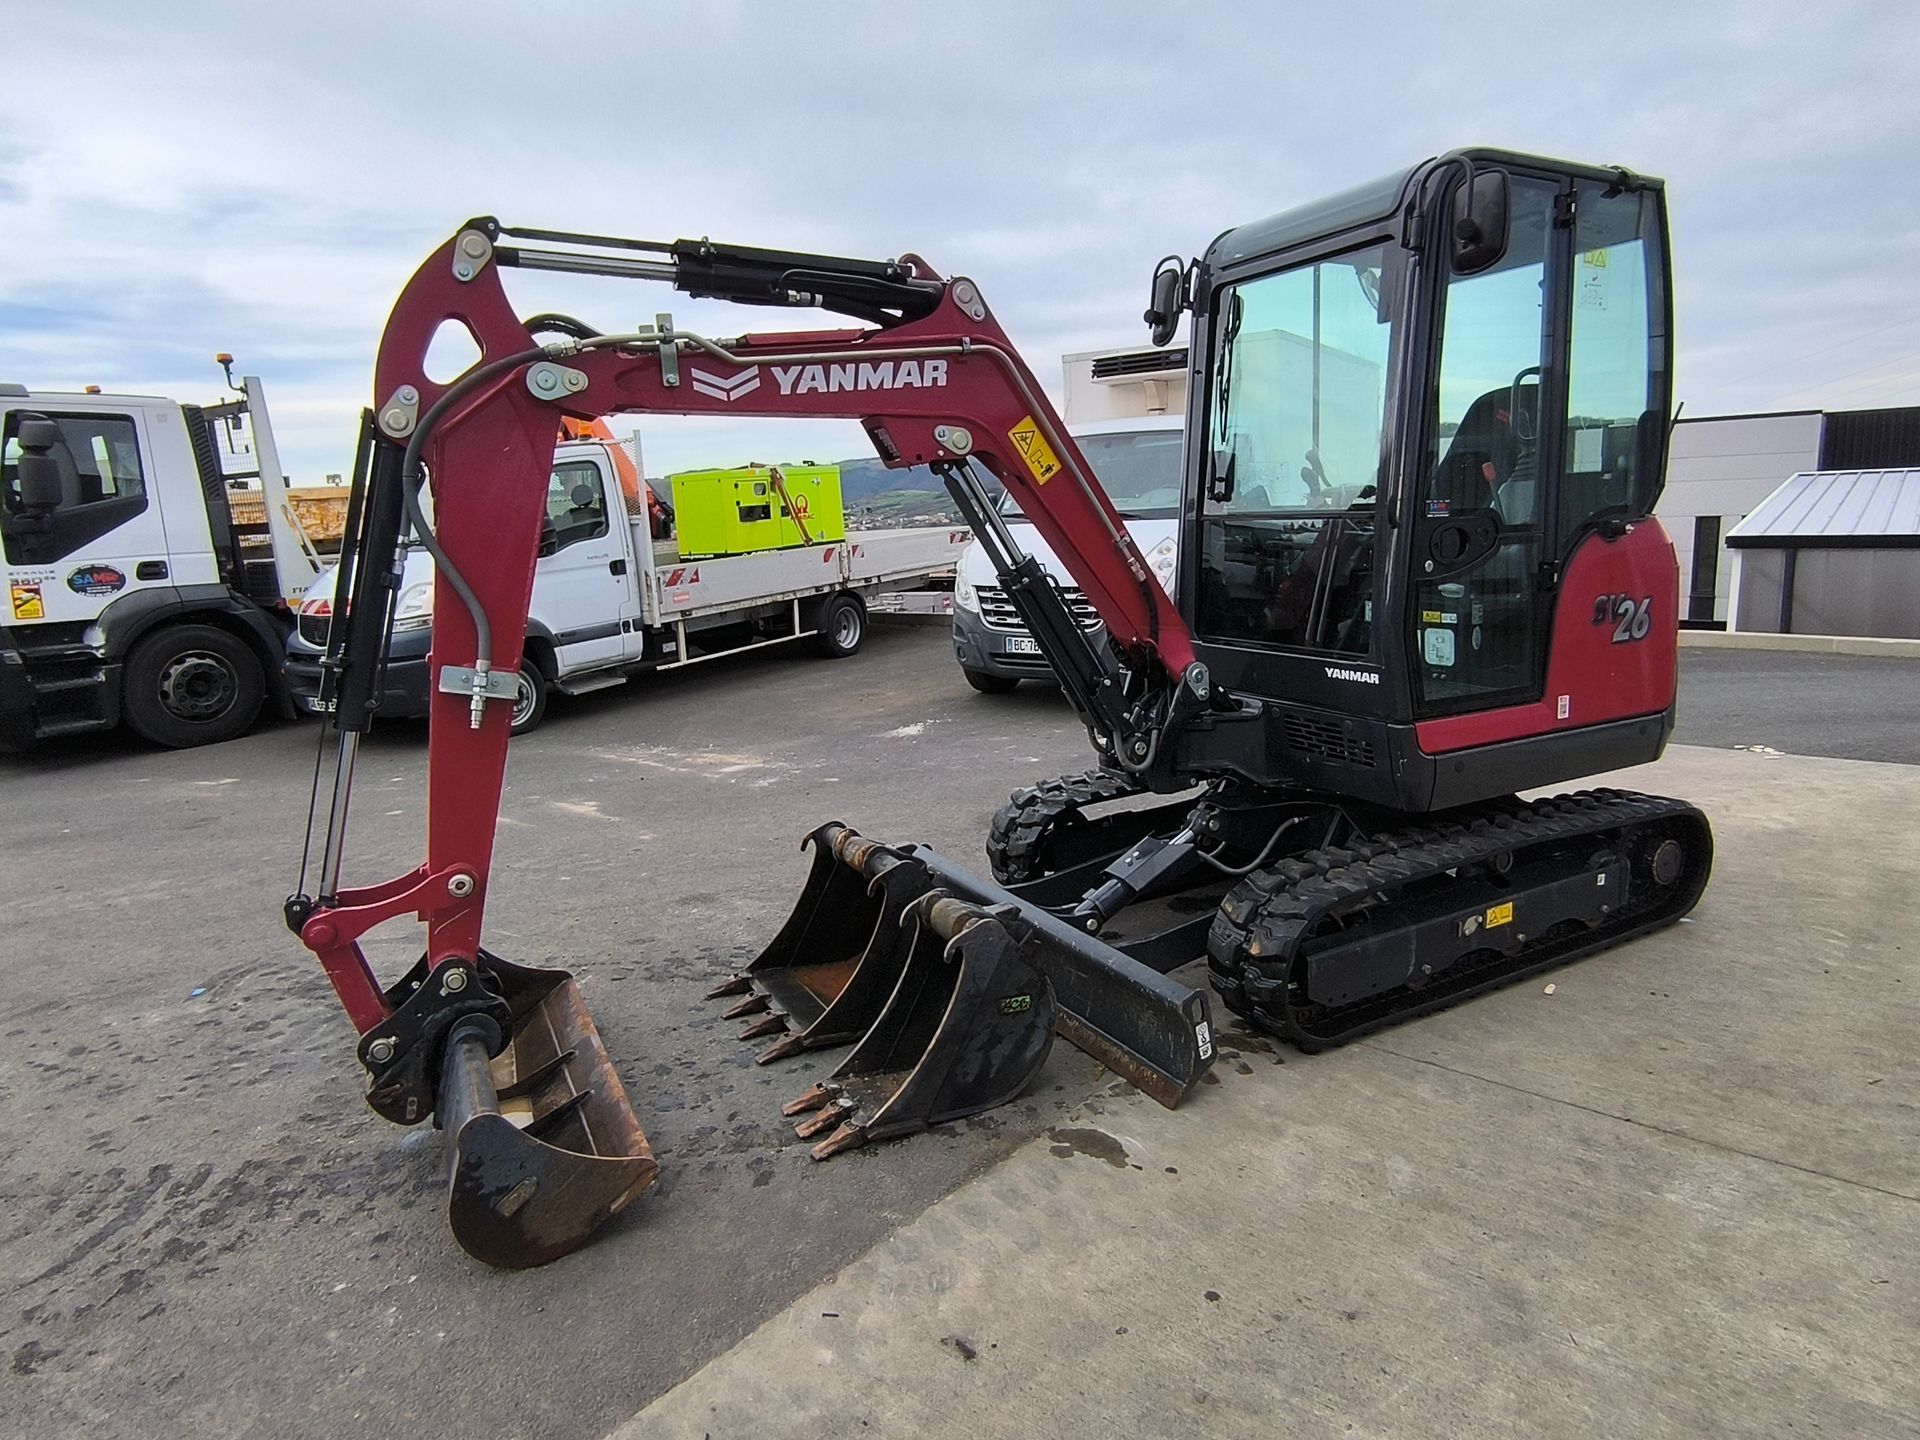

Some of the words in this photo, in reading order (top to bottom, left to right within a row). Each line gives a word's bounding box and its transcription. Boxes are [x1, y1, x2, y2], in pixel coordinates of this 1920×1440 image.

[770, 359, 948, 395] YANMAR
[1611, 596, 1653, 644] 26
[1324, 666, 1380, 685] YANMAR
